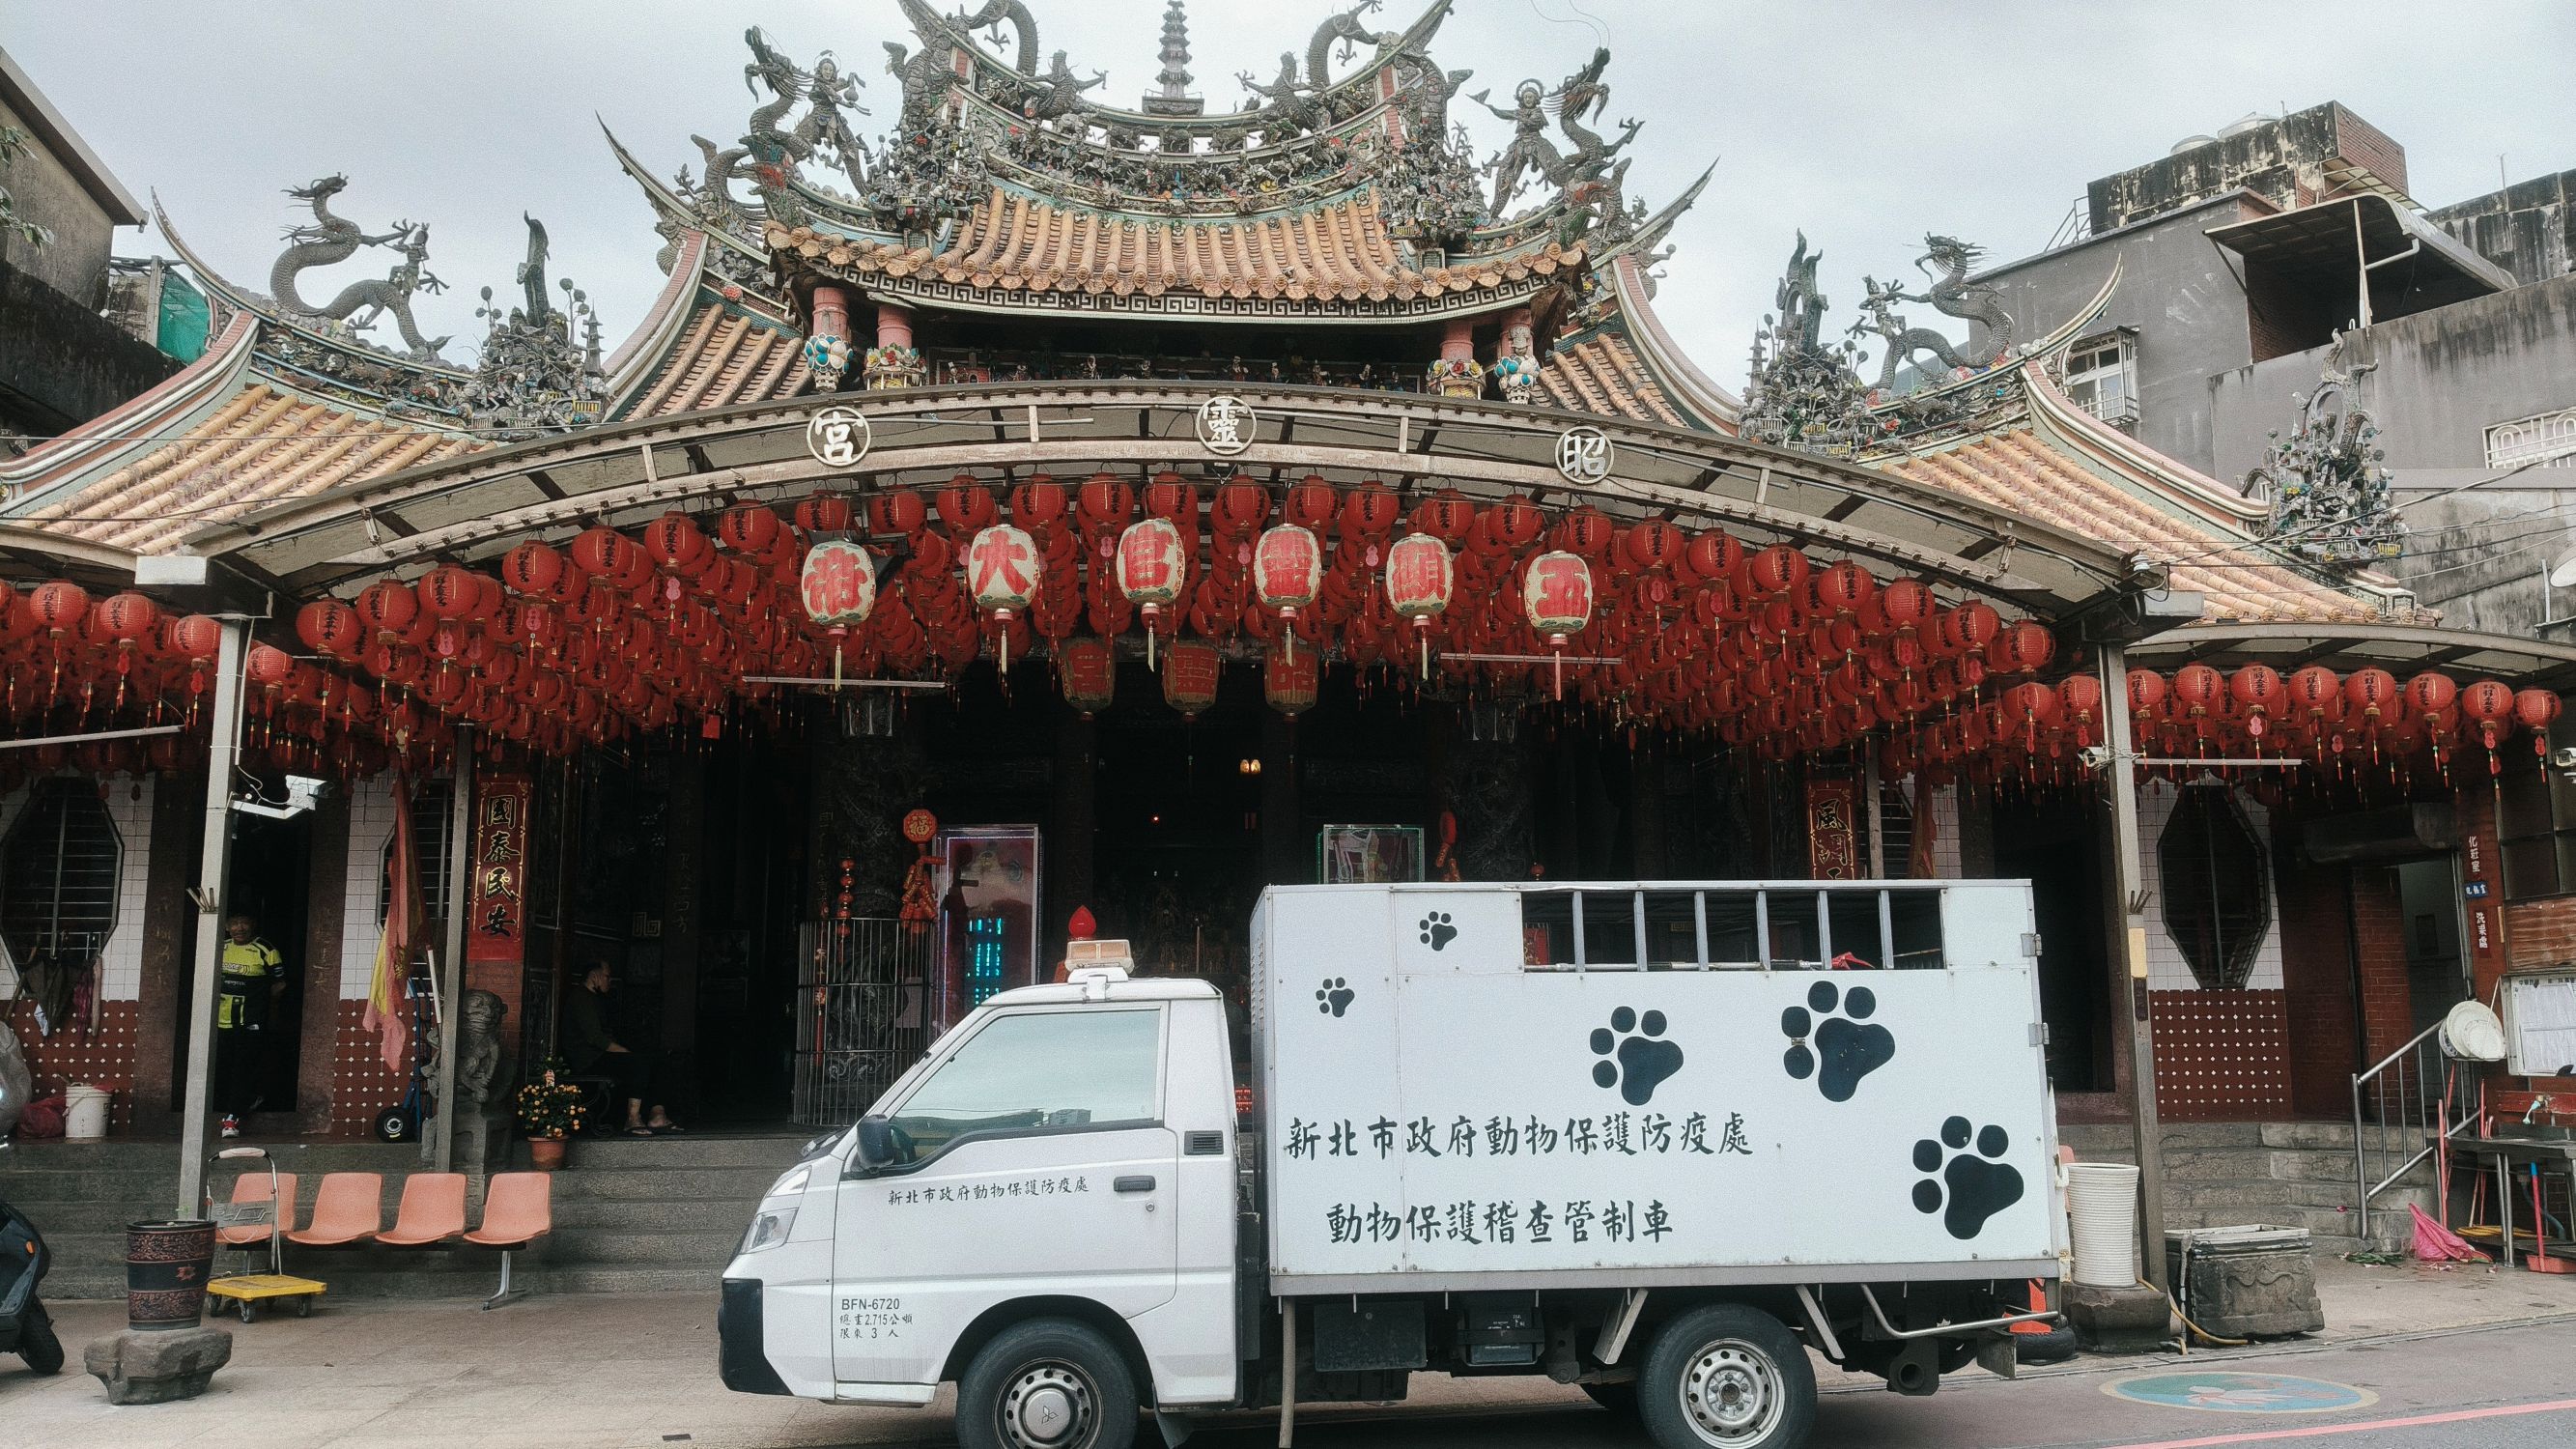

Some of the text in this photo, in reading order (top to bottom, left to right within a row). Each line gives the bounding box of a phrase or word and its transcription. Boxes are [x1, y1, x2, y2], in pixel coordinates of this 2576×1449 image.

[813, 399, 1608, 479] 昭 靈 宮
[973, 530, 1033, 597] 大
[479, 794, 521, 937] 國泰民安
[1286, 1111, 1754, 1161] 新北市政府動物保護防疫處
[888, 1176, 1090, 1206] 新北市政府動物保護防疫處
[1326, 1199, 1673, 1245] 動物保護稽查管制車
[841, 1297, 900, 1311] BFN-6720
